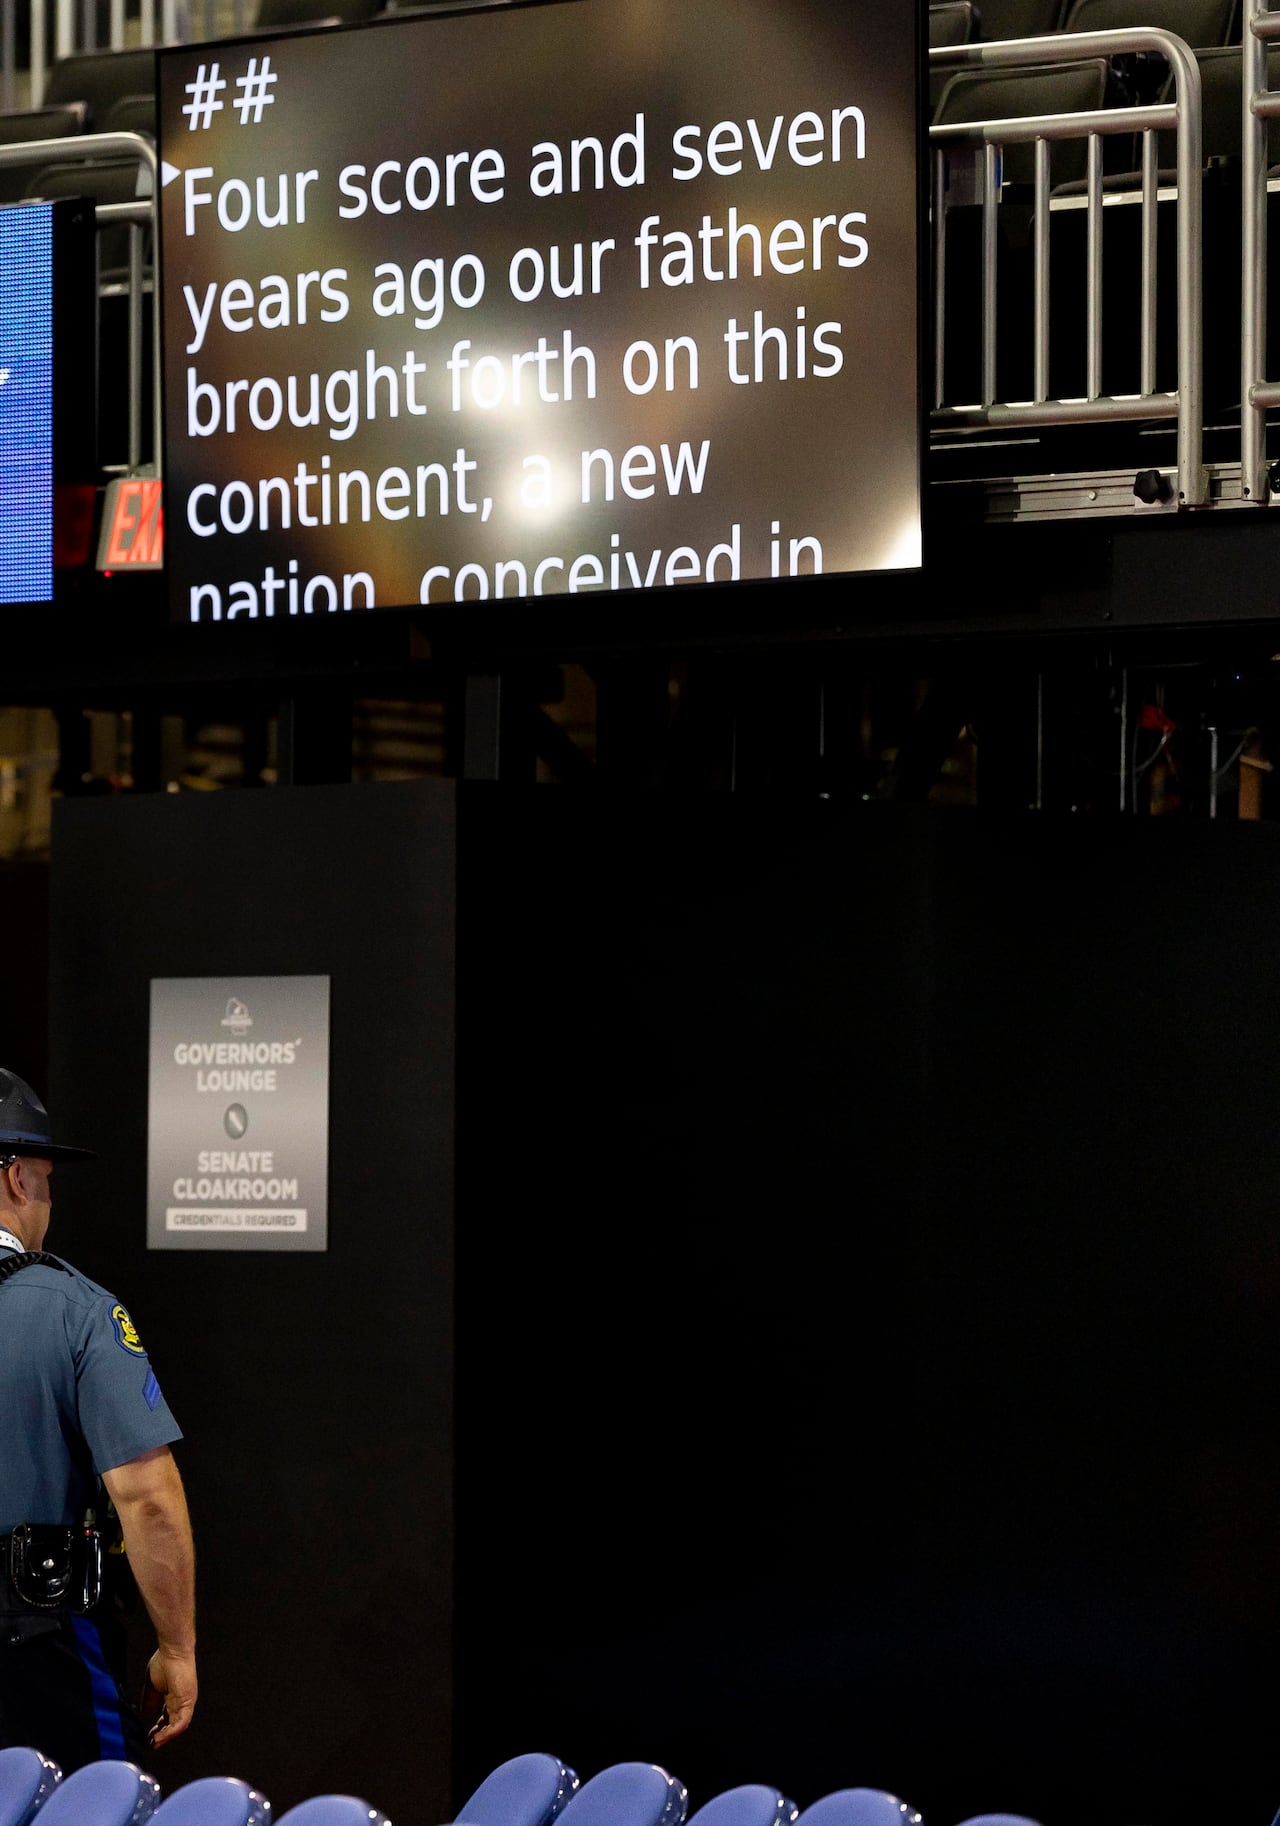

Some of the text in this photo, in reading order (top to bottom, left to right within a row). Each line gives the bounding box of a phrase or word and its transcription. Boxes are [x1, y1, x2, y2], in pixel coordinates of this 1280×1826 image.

[182, 56, 278, 131] ##
[184, 106, 866, 236] Four score and seven
[183, 207, 869, 354] years ago our fathers
[187, 306, 843, 441] brought forth on this
[106, 481, 164, 564] EXI
[187, 440, 710, 537] continent, a new
[420, 524, 741, 605] conceived
[771, 520, 823, 578] in
[196, 1070, 277, 1092] LOUNGE
[173, 1178, 298, 1200] CLOAKROOM
[197, 1152, 274, 1173] SENATE
[173, 1214, 297, 1227] CREDENTIALS REQUIRED
